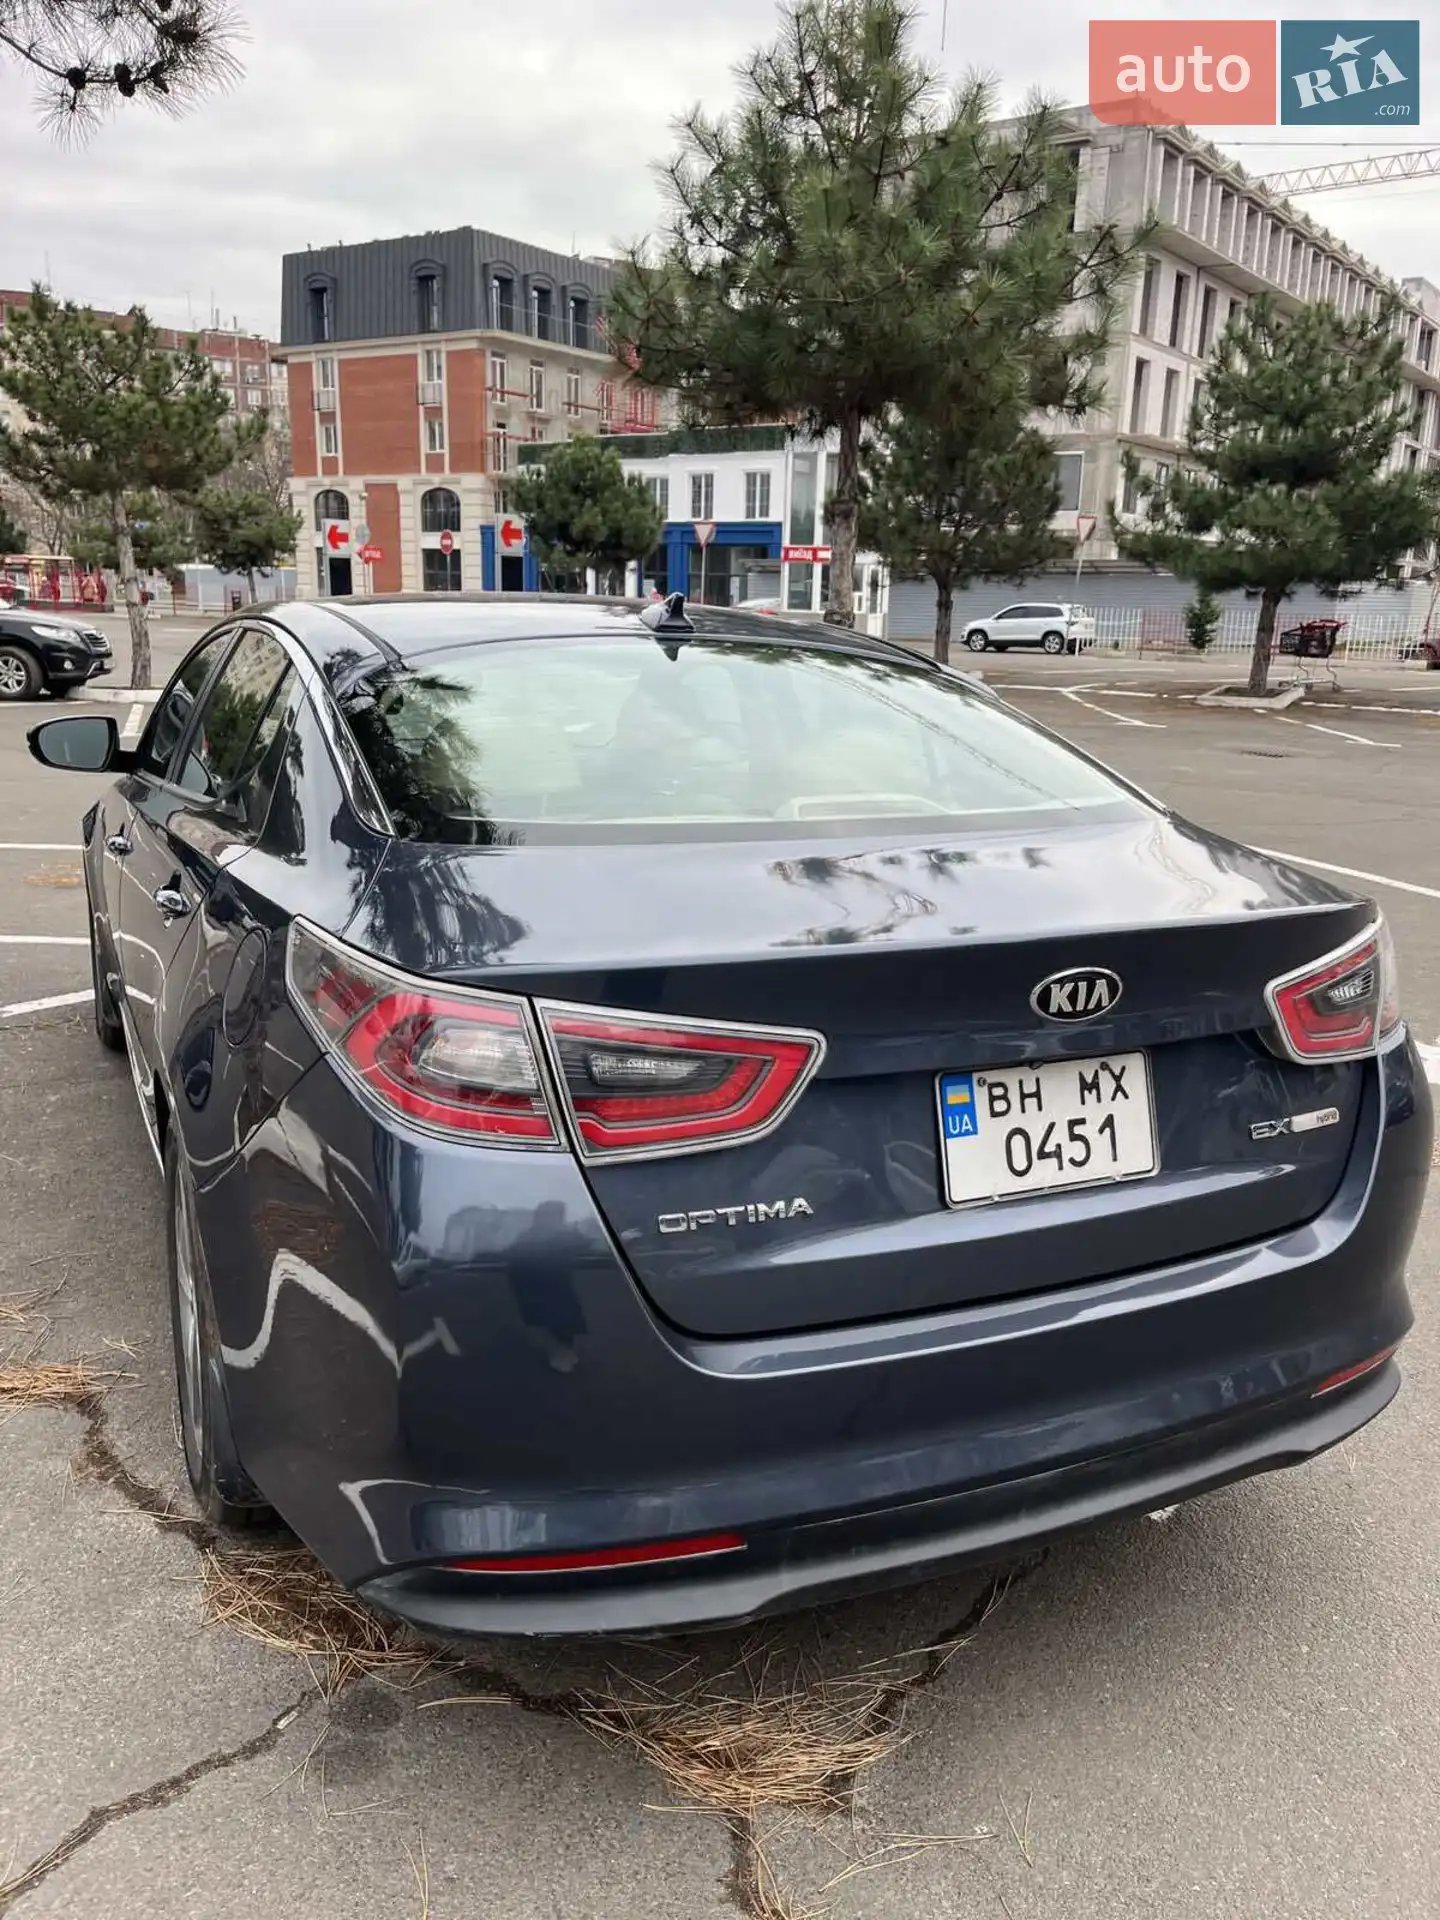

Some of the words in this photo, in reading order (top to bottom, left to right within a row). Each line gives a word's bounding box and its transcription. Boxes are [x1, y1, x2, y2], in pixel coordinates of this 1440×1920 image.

[1048, 978, 1111, 1014] KIA
[987, 1076, 1044, 1118] BH
[1079, 1064, 1131, 1106] MX
[948, 1113, 975, 1137] UA
[1250, 1117, 1290, 1140] EX
[1004, 1113, 1119, 1178] 0451
[657, 1196, 814, 1234] OPTIMA
